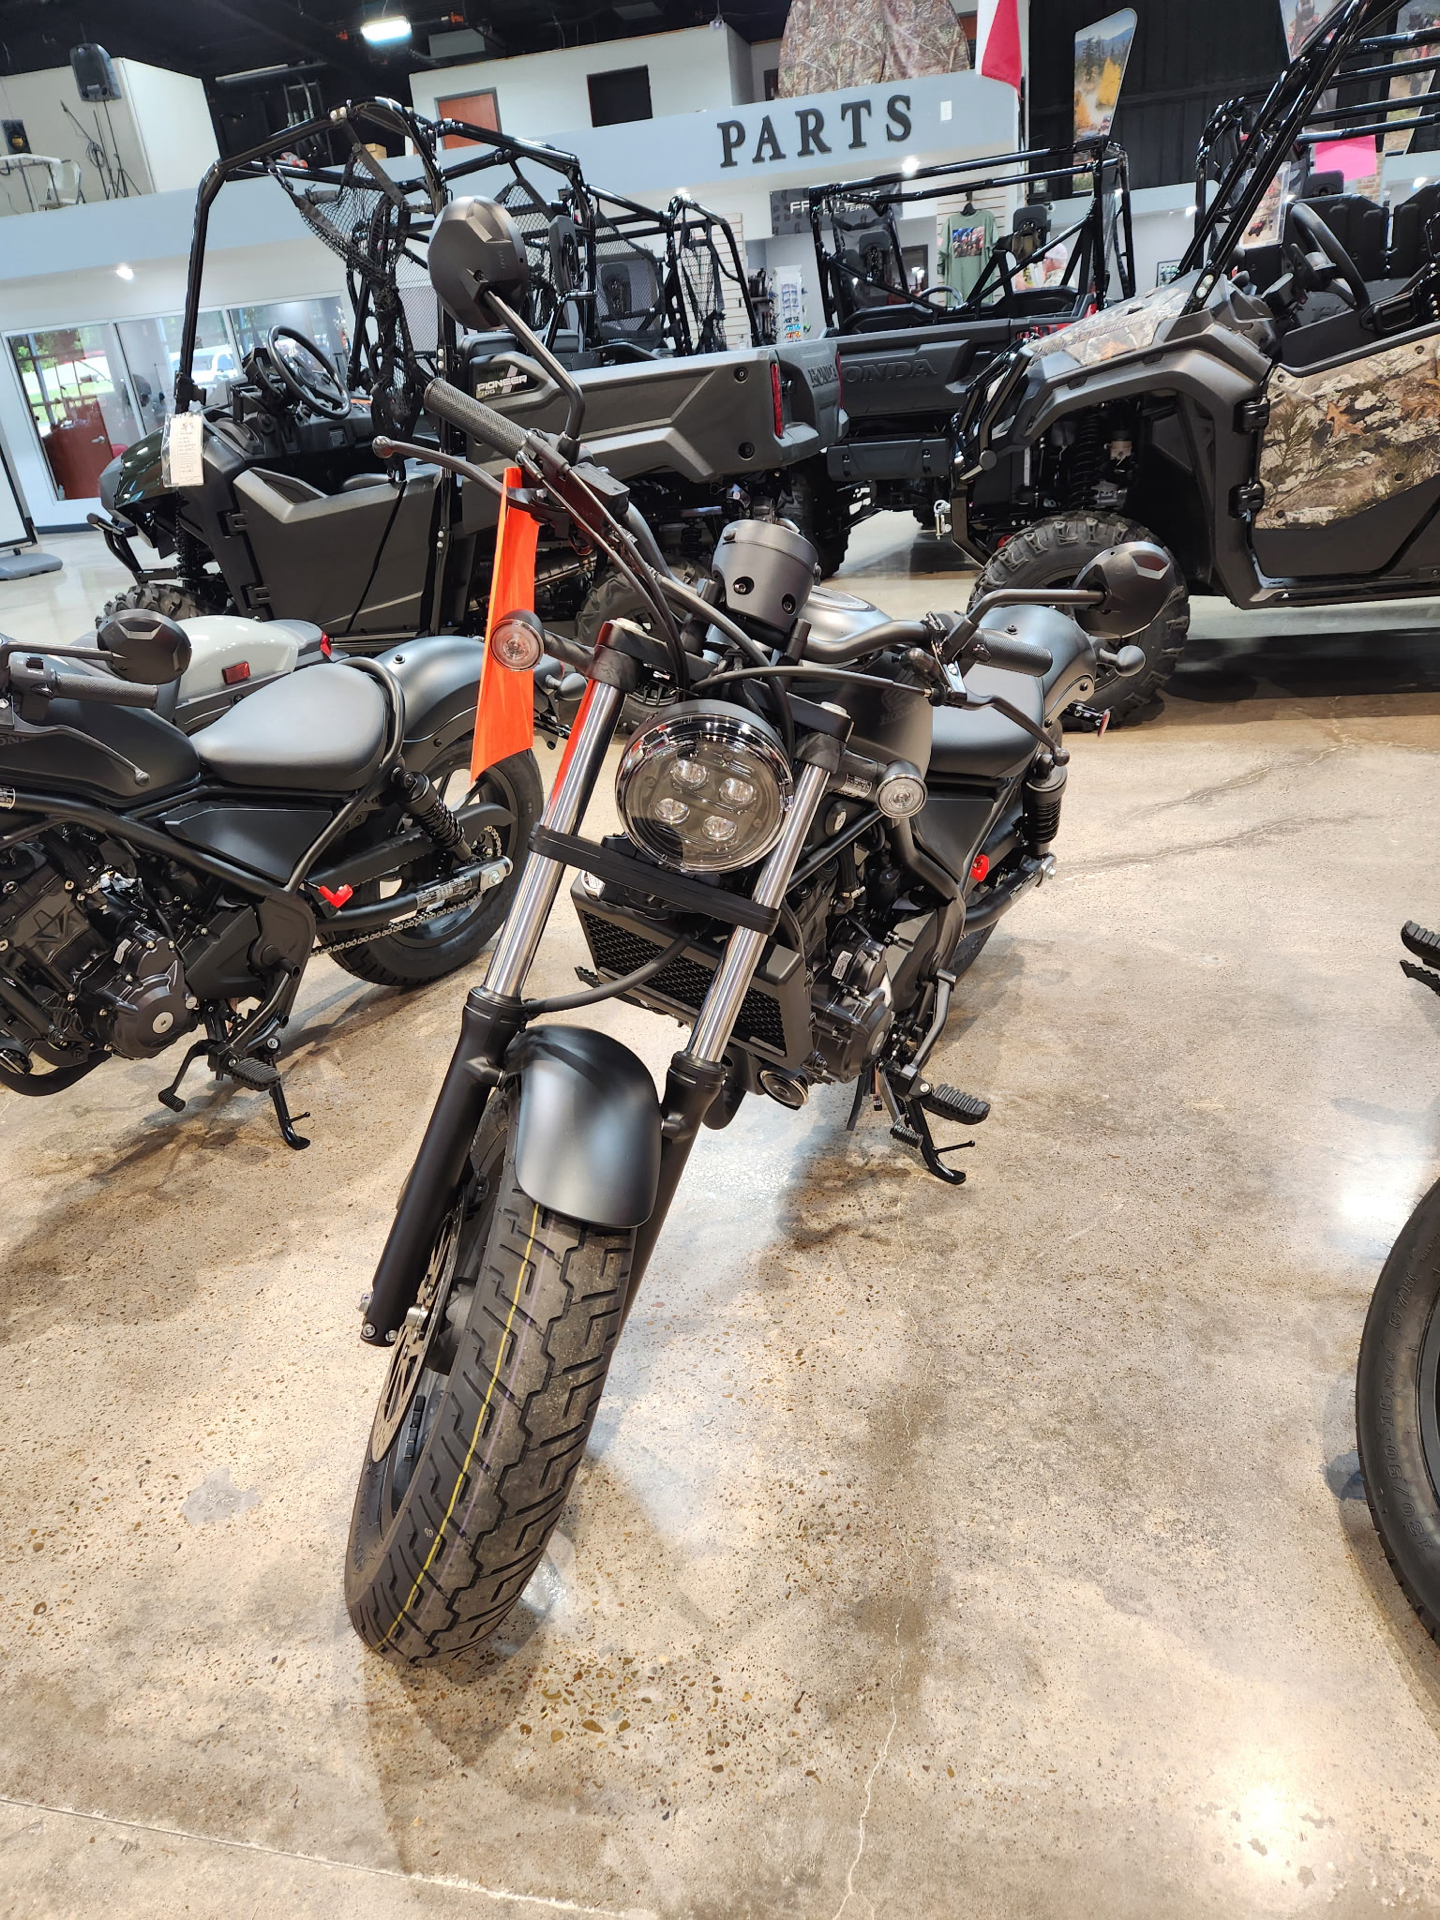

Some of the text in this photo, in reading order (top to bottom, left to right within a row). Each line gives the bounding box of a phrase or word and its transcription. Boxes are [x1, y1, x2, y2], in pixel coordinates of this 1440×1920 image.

[716, 94, 912, 168] PARTS
[476, 375, 528, 391] PIONEER
[841, 358, 938, 383] ONDA
